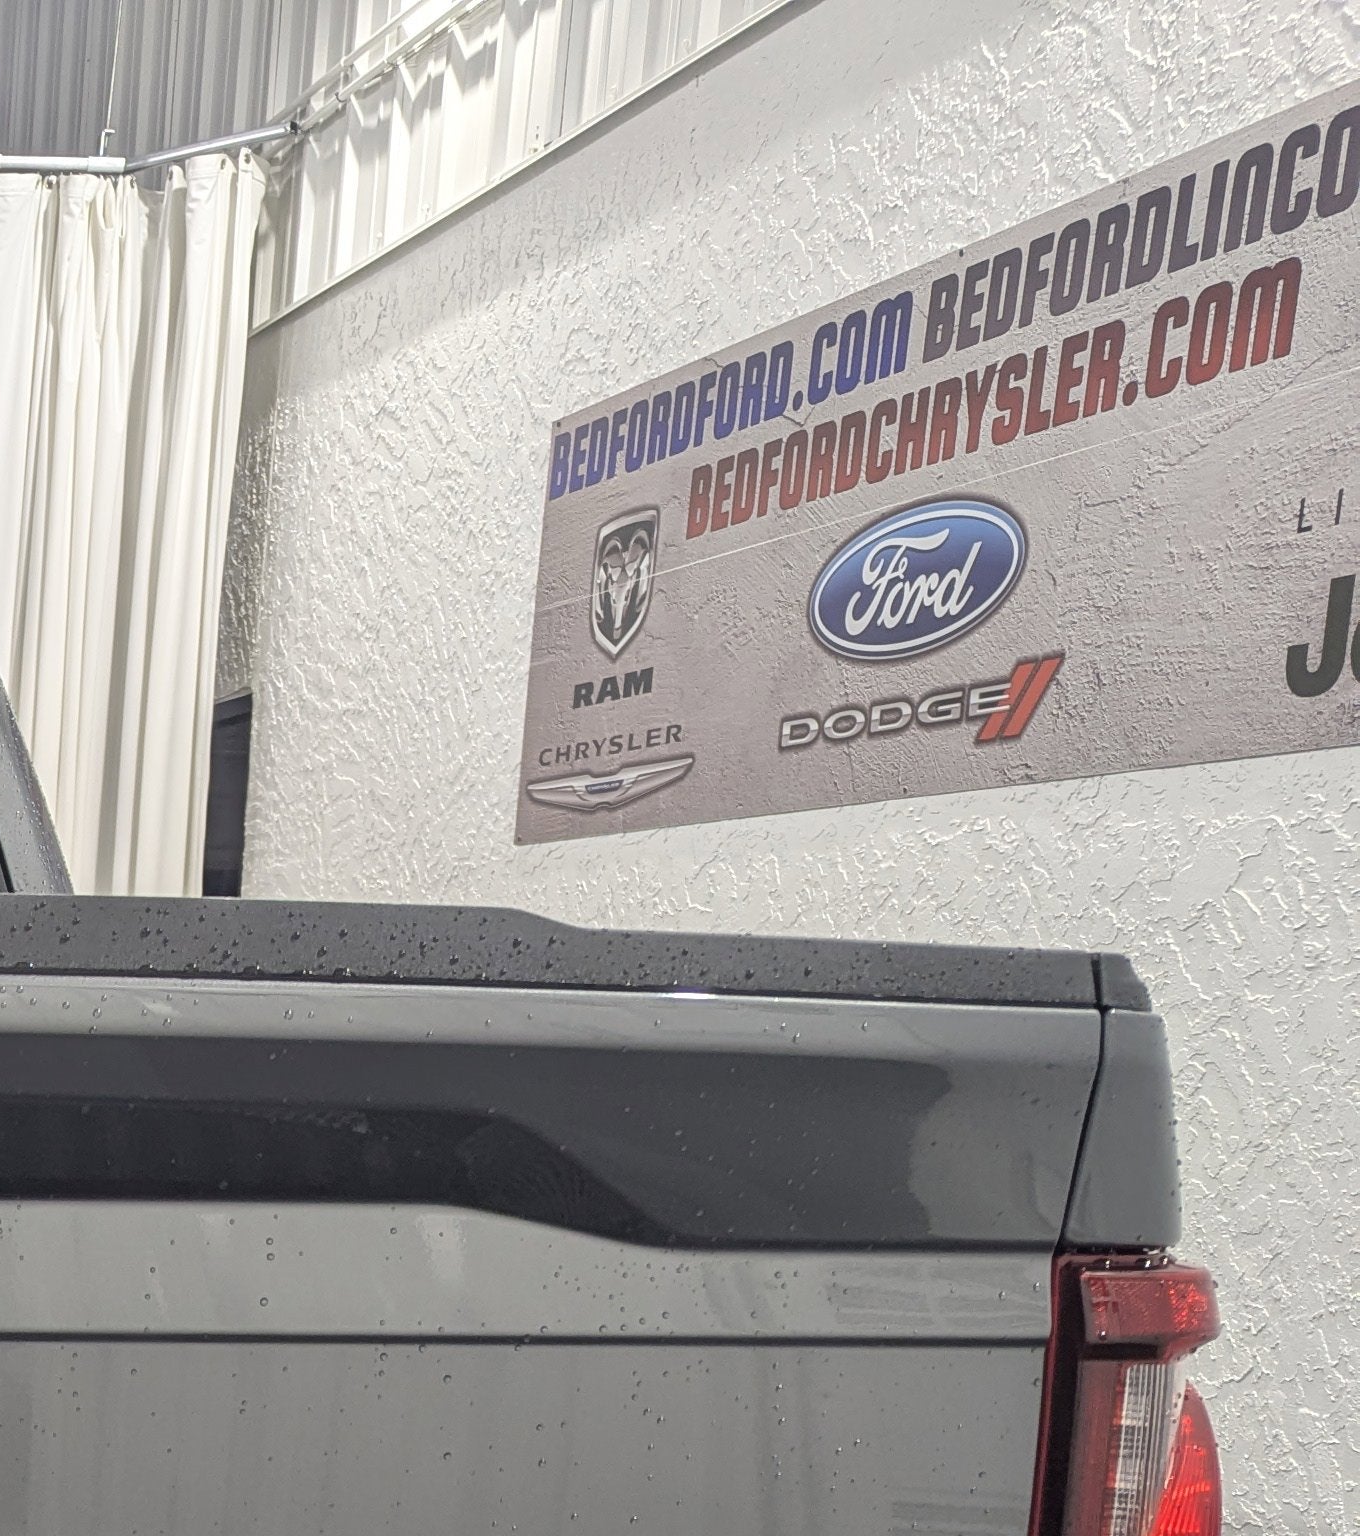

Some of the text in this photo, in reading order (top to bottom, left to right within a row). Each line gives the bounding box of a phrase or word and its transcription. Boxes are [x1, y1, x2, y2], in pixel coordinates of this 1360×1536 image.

[548, 104, 1360, 502] BEDFORDFORD.COM BEDFORDLINCO
[685, 256, 1303, 541] BEDFORDCHRYSLER.COM
[844, 527, 983, 637] Ford
[1285, 573, 1360, 698] J
[572, 666, 655, 710] RAM
[780, 682, 1012, 748] DODGE
[537, 723, 683, 767] CHRYSLER
